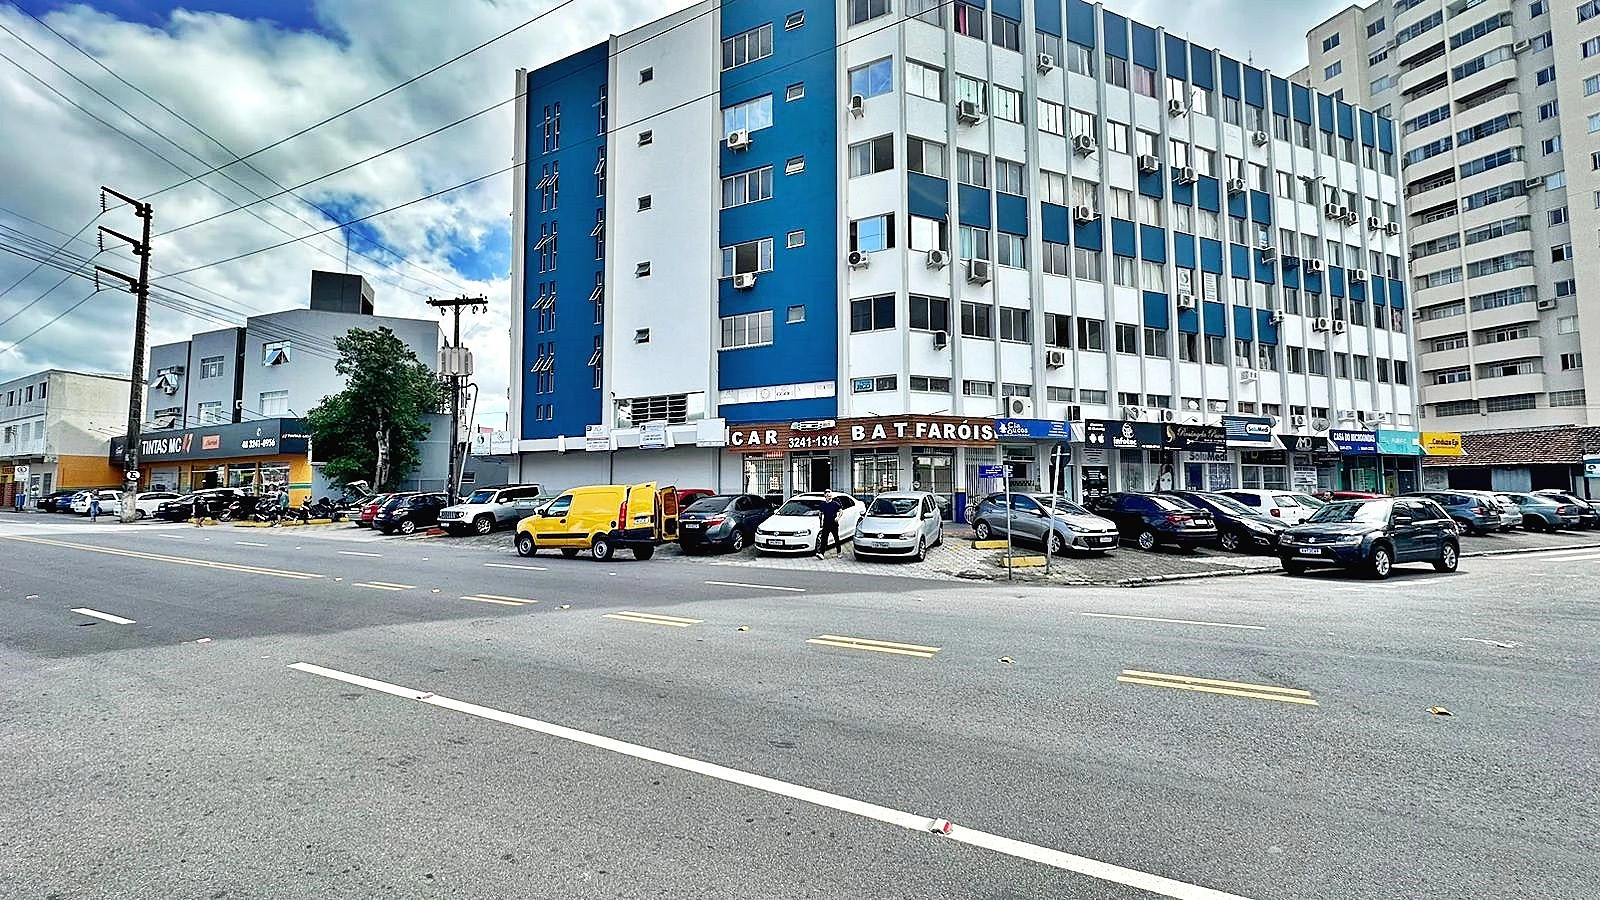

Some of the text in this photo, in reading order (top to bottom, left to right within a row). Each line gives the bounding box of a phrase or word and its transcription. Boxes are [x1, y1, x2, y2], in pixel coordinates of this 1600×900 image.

[915, 419, 993, 440] FARÓIS
[141, 438, 168, 455] TINTAS
[168, 437, 182, 453] MC
[788, 434, 840, 448] 3241-1314
